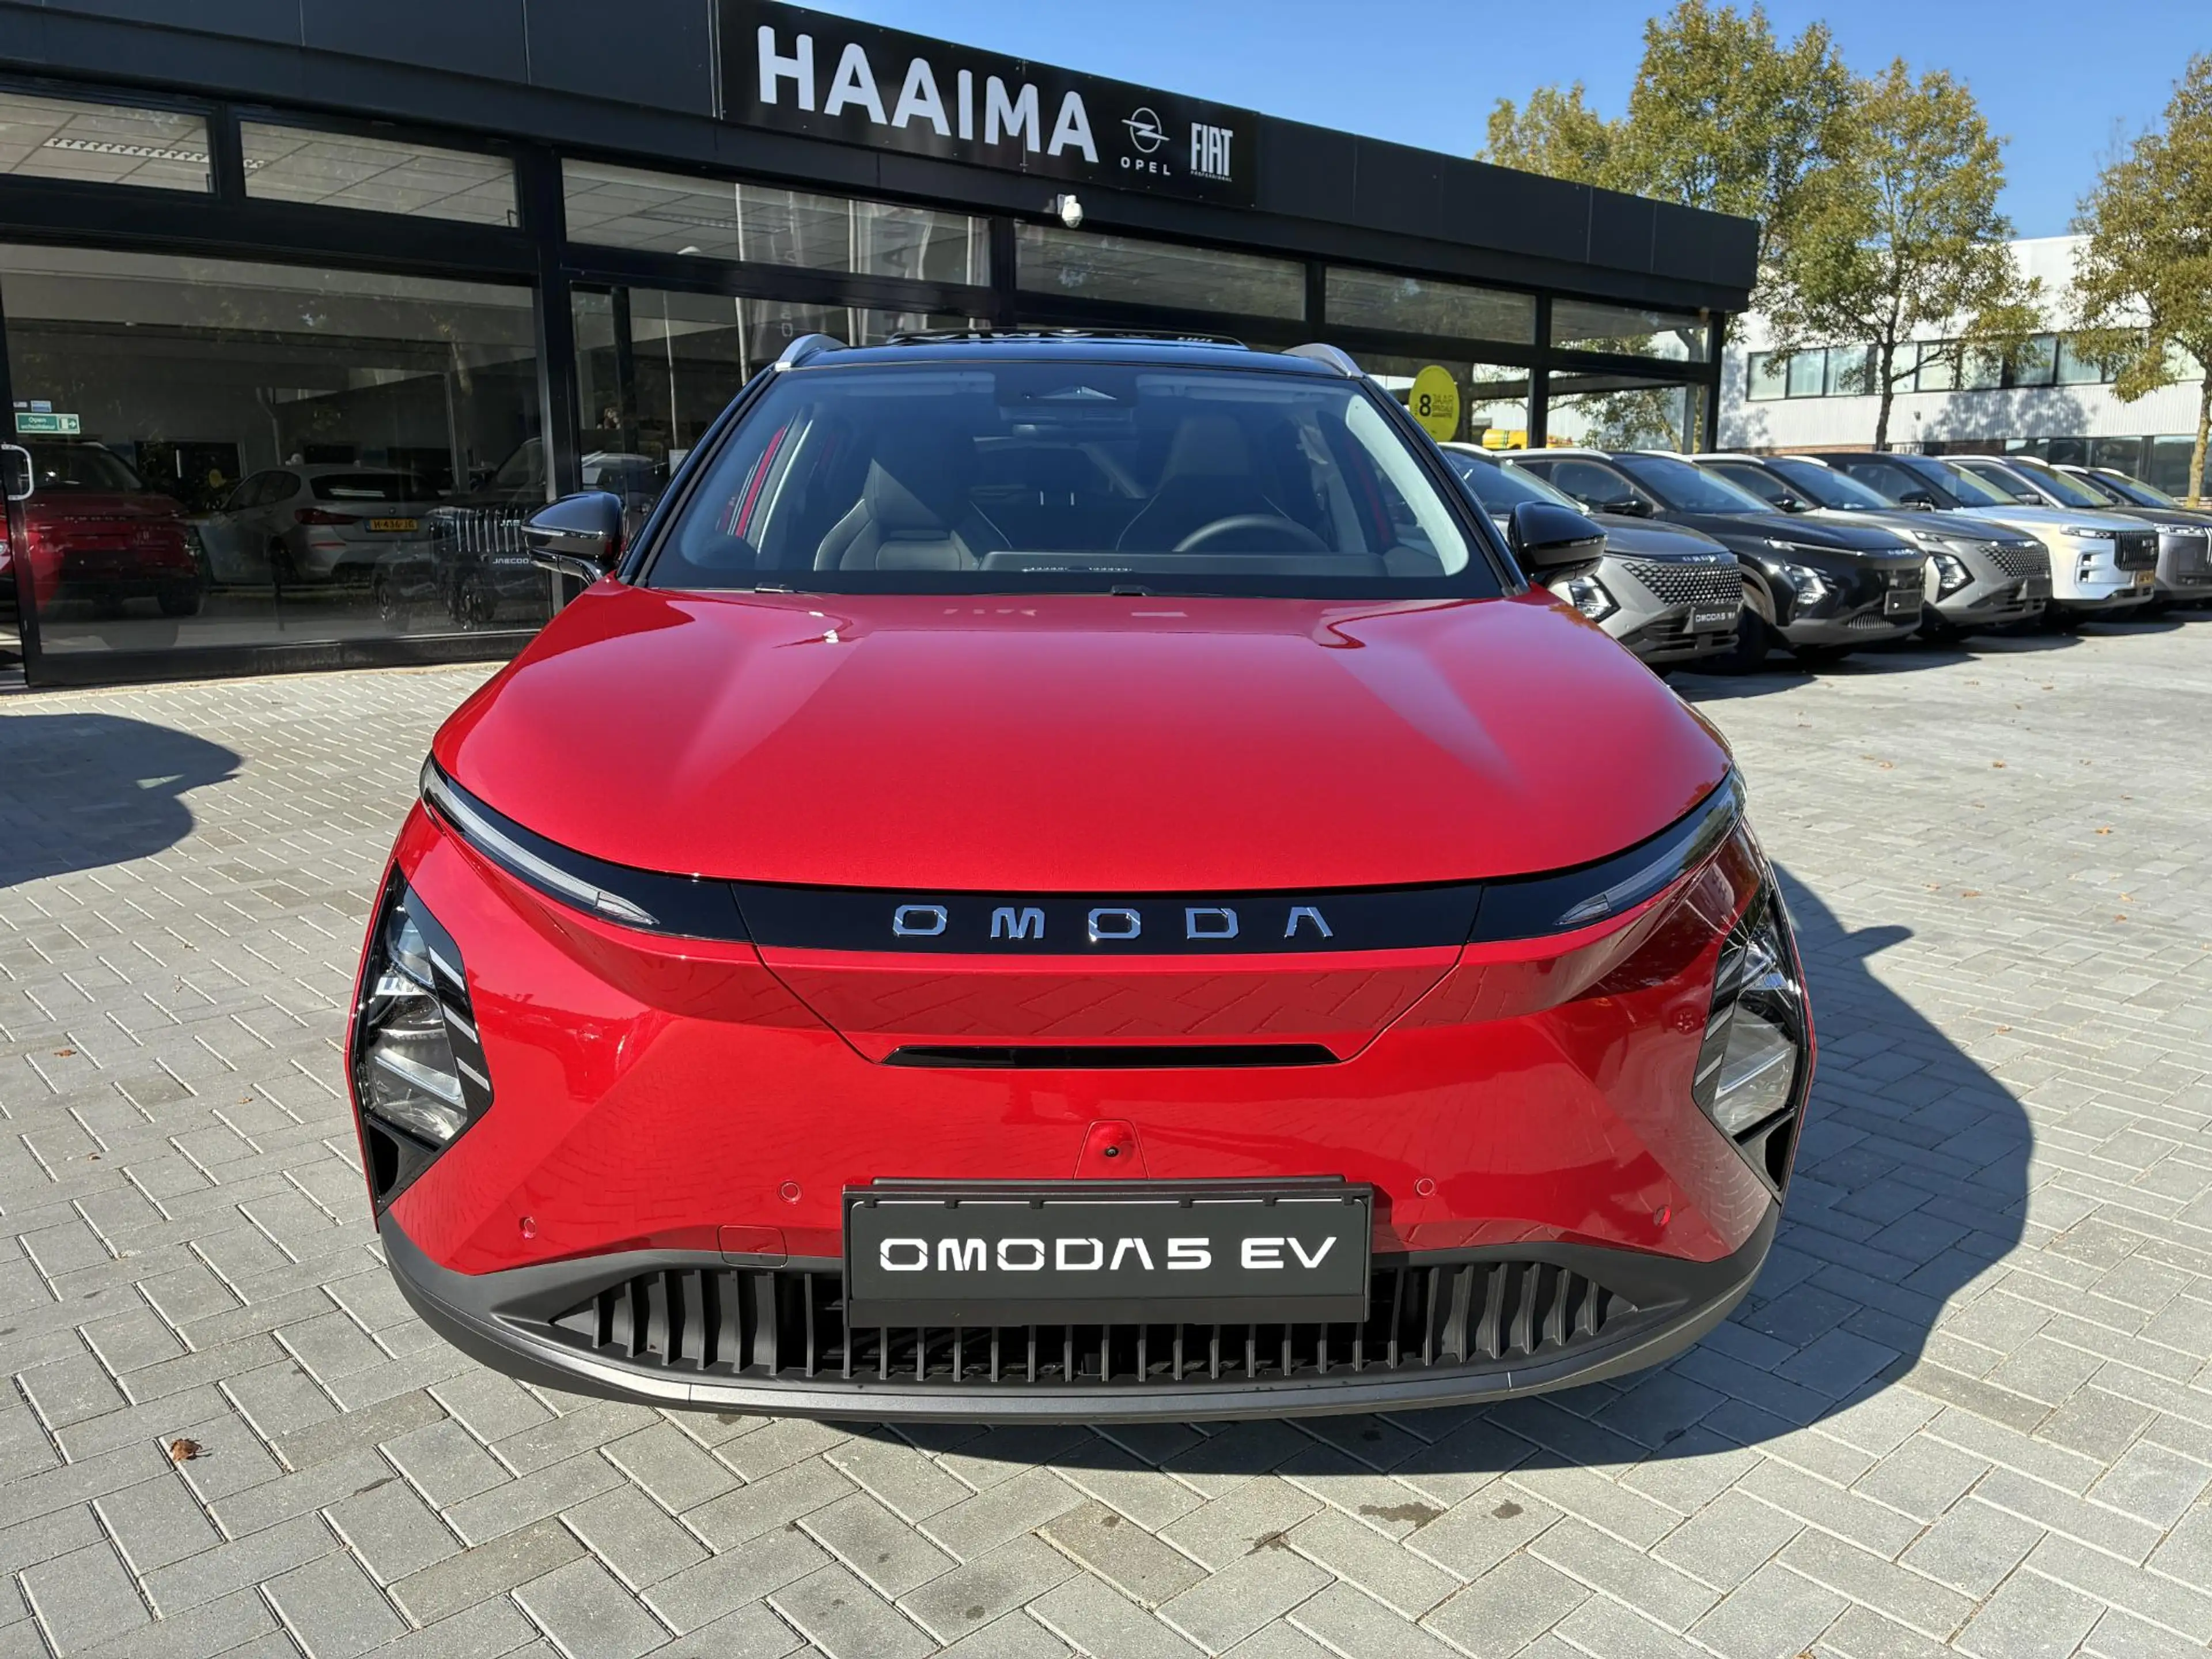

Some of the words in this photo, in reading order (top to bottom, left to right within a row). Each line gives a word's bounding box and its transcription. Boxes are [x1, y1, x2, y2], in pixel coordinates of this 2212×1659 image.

[757, 26, 1099, 163] HAAIMA
[1120, 157, 1171, 176] OPEL
[1191, 122, 1233, 177] FIAT
[1419, 393, 1431, 416] 8
[892, 904, 1334, 940] OMODA
[1240, 1236, 1337, 1270] EV
